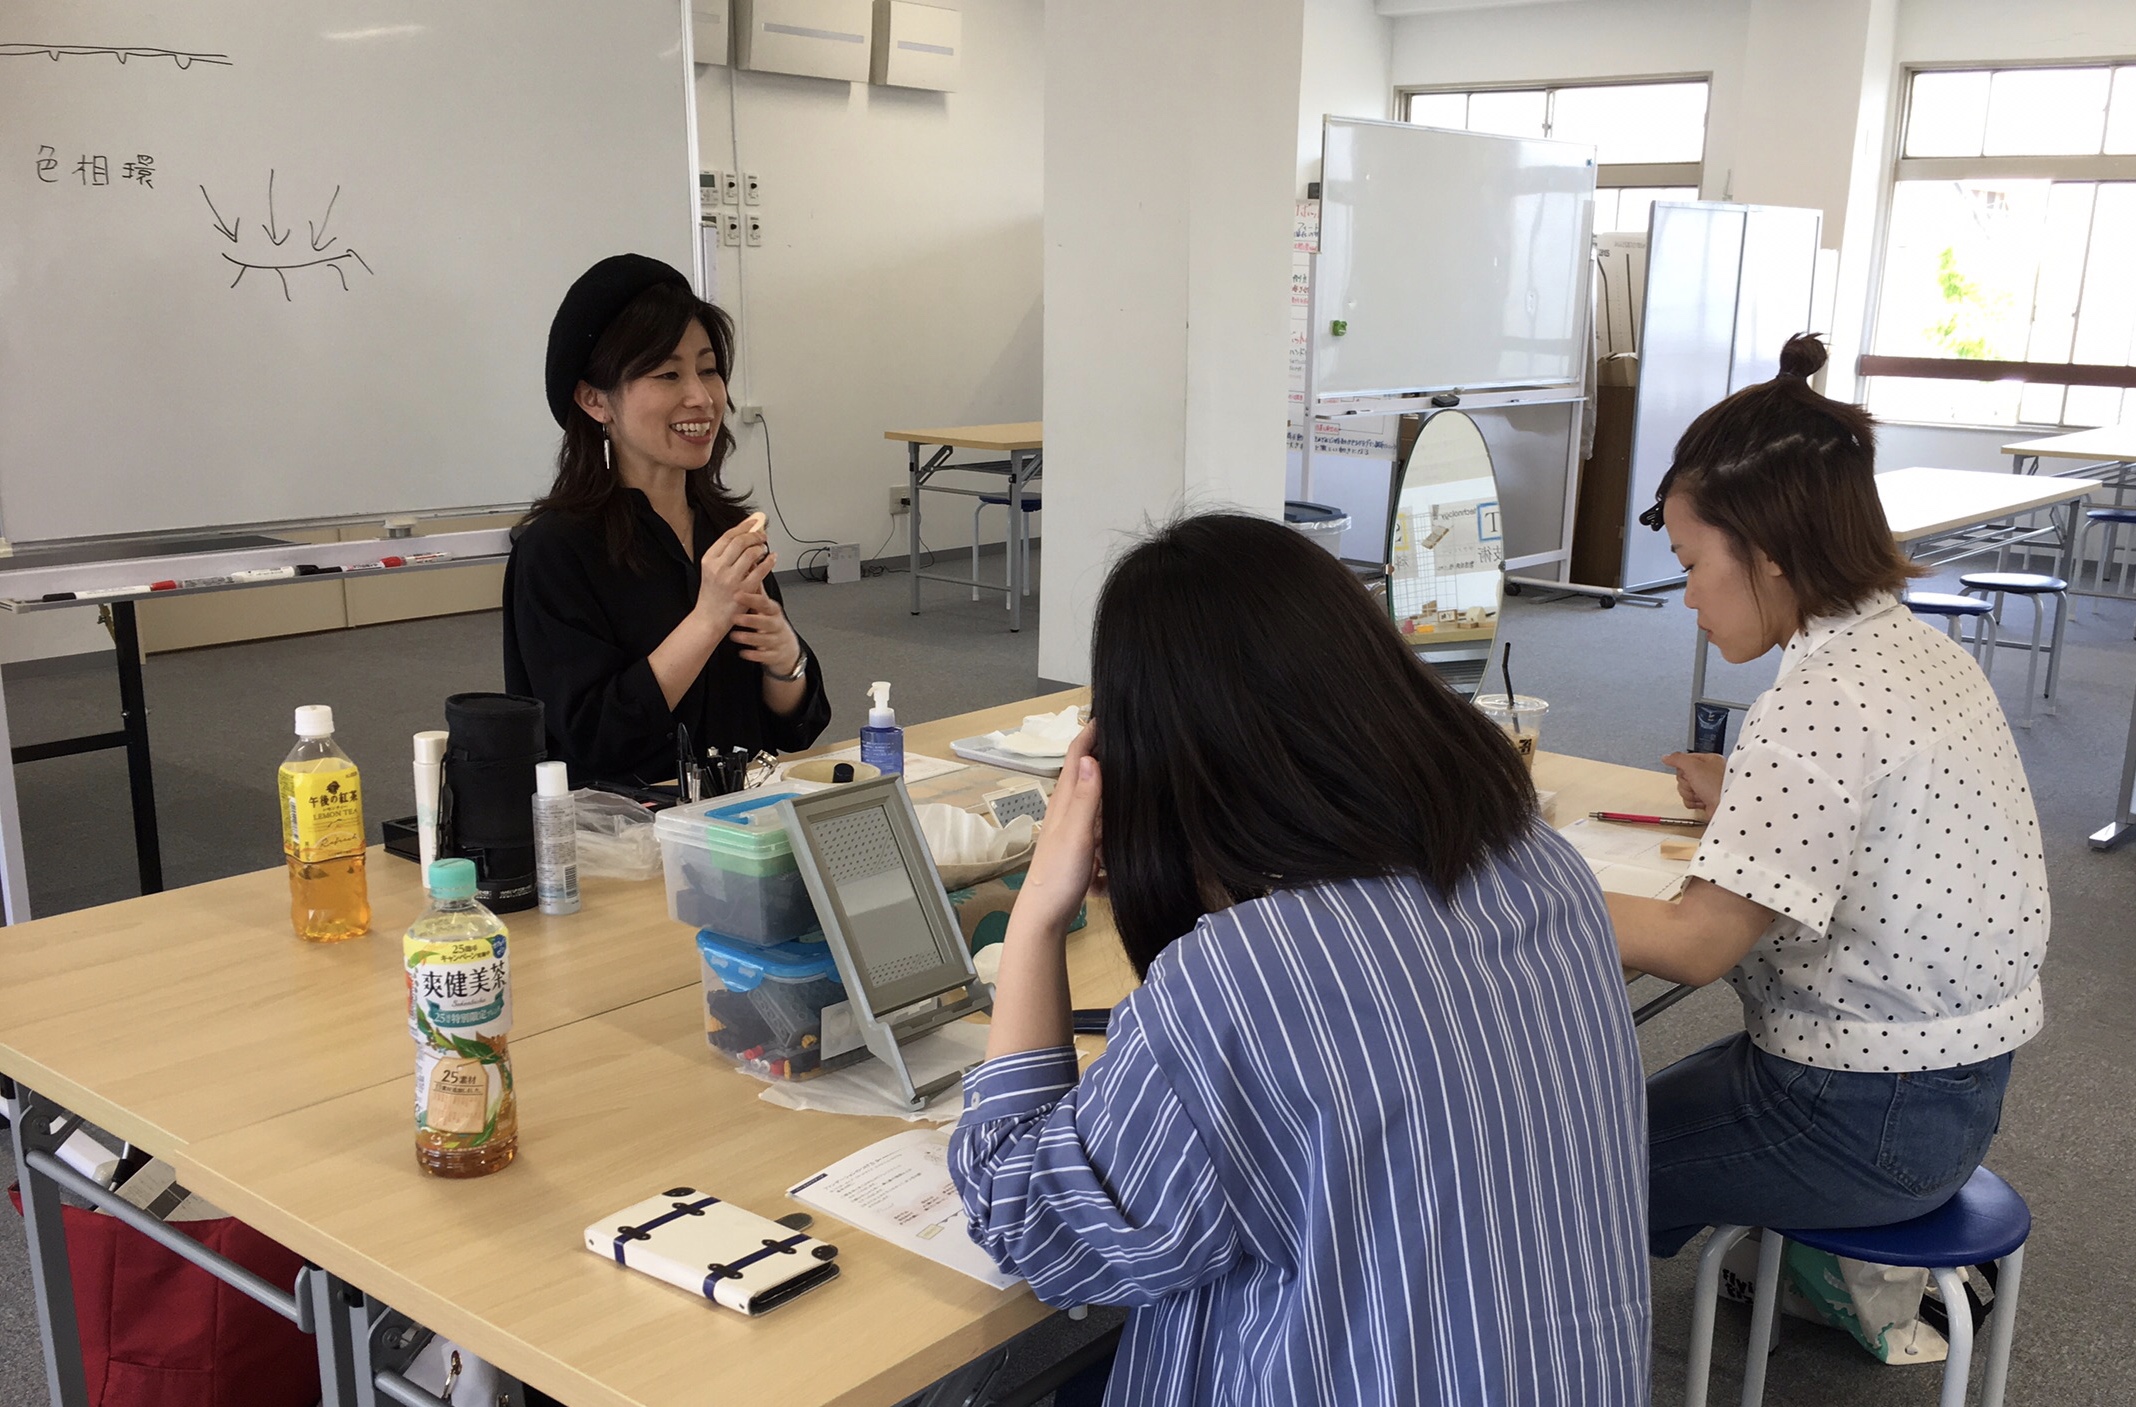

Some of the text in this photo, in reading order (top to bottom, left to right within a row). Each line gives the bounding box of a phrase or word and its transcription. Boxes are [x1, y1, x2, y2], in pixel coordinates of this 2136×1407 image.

[36, 144, 156, 189] 色相環
[308, 789, 358, 808] 午後の紅茶
[313, 807, 358, 821] LEMON TEA
[421, 960, 508, 999] 爽健美茶
